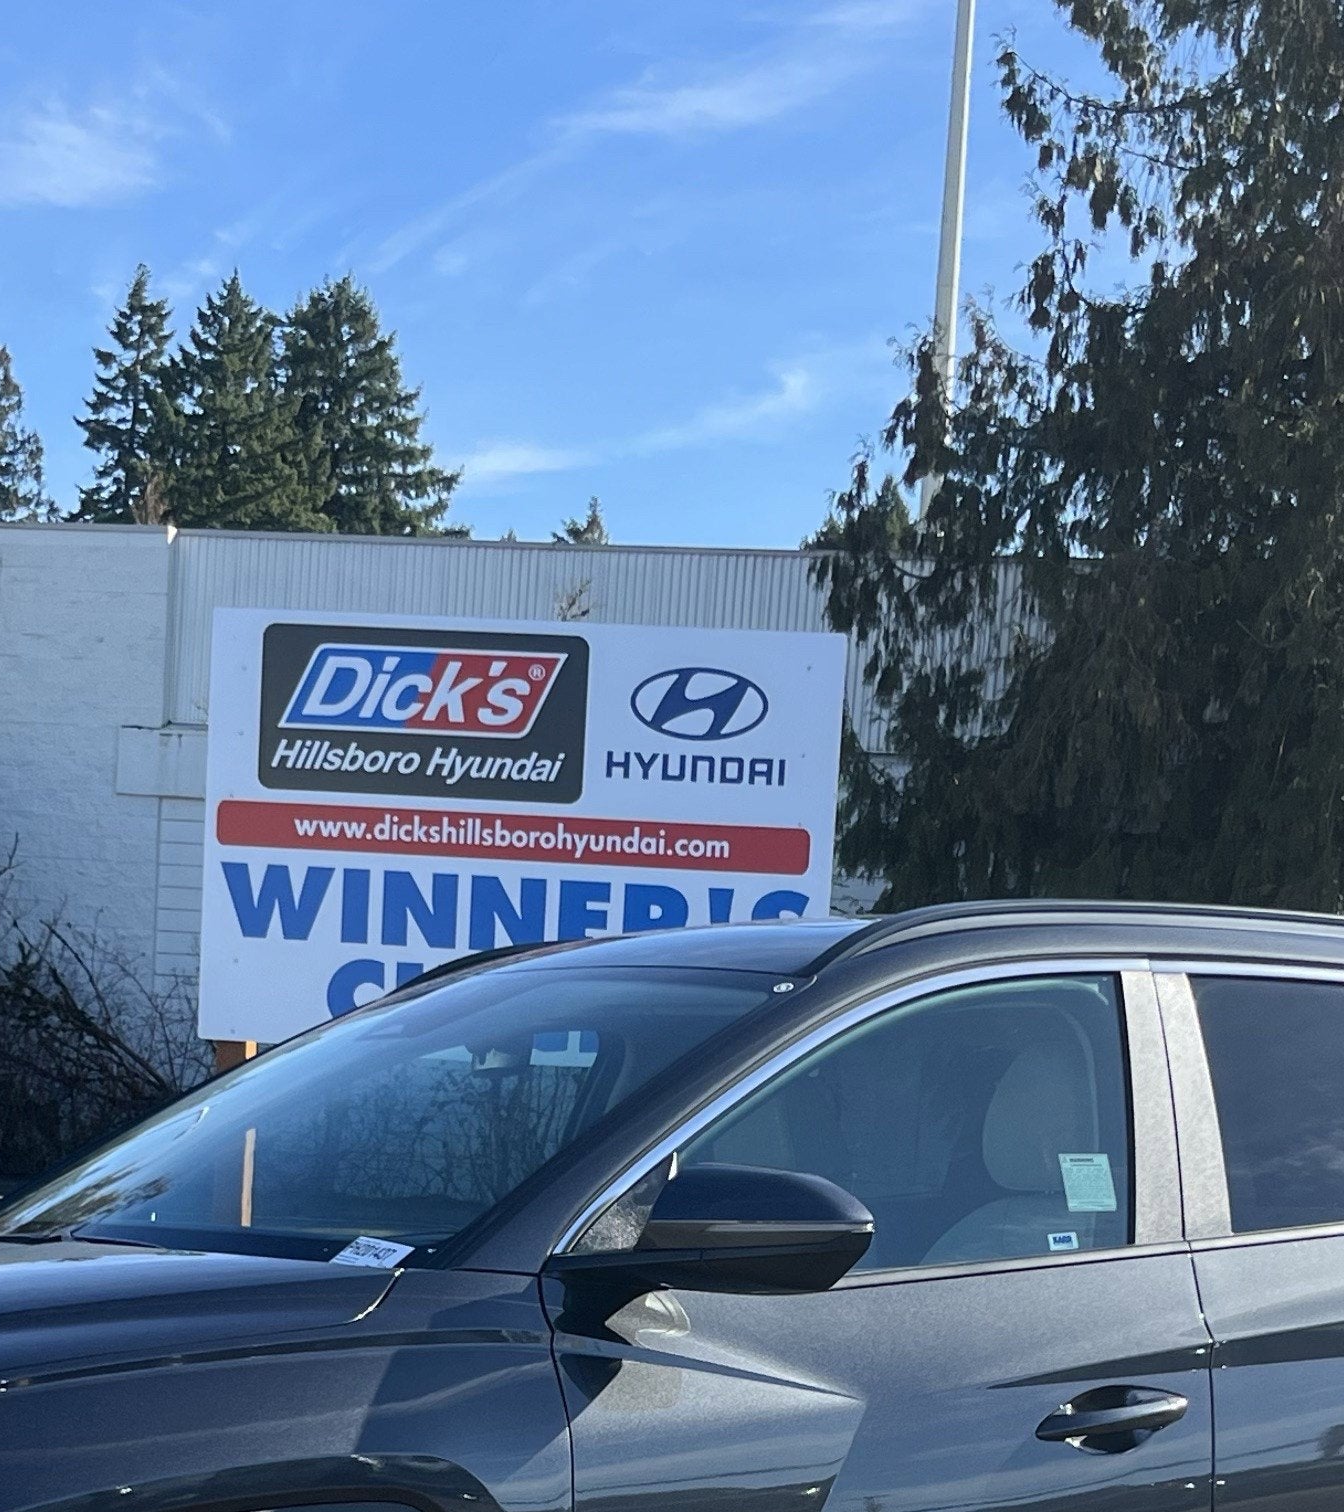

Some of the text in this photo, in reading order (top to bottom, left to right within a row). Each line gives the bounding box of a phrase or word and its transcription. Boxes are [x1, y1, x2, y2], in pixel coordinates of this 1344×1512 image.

[301, 655, 531, 726] Dick's
[270, 739, 566, 785] Hillsboro Hyundai
[605, 750, 786, 787] HYUNDAI
[293, 813, 730, 860] www.dickshillsborohyundai.com
